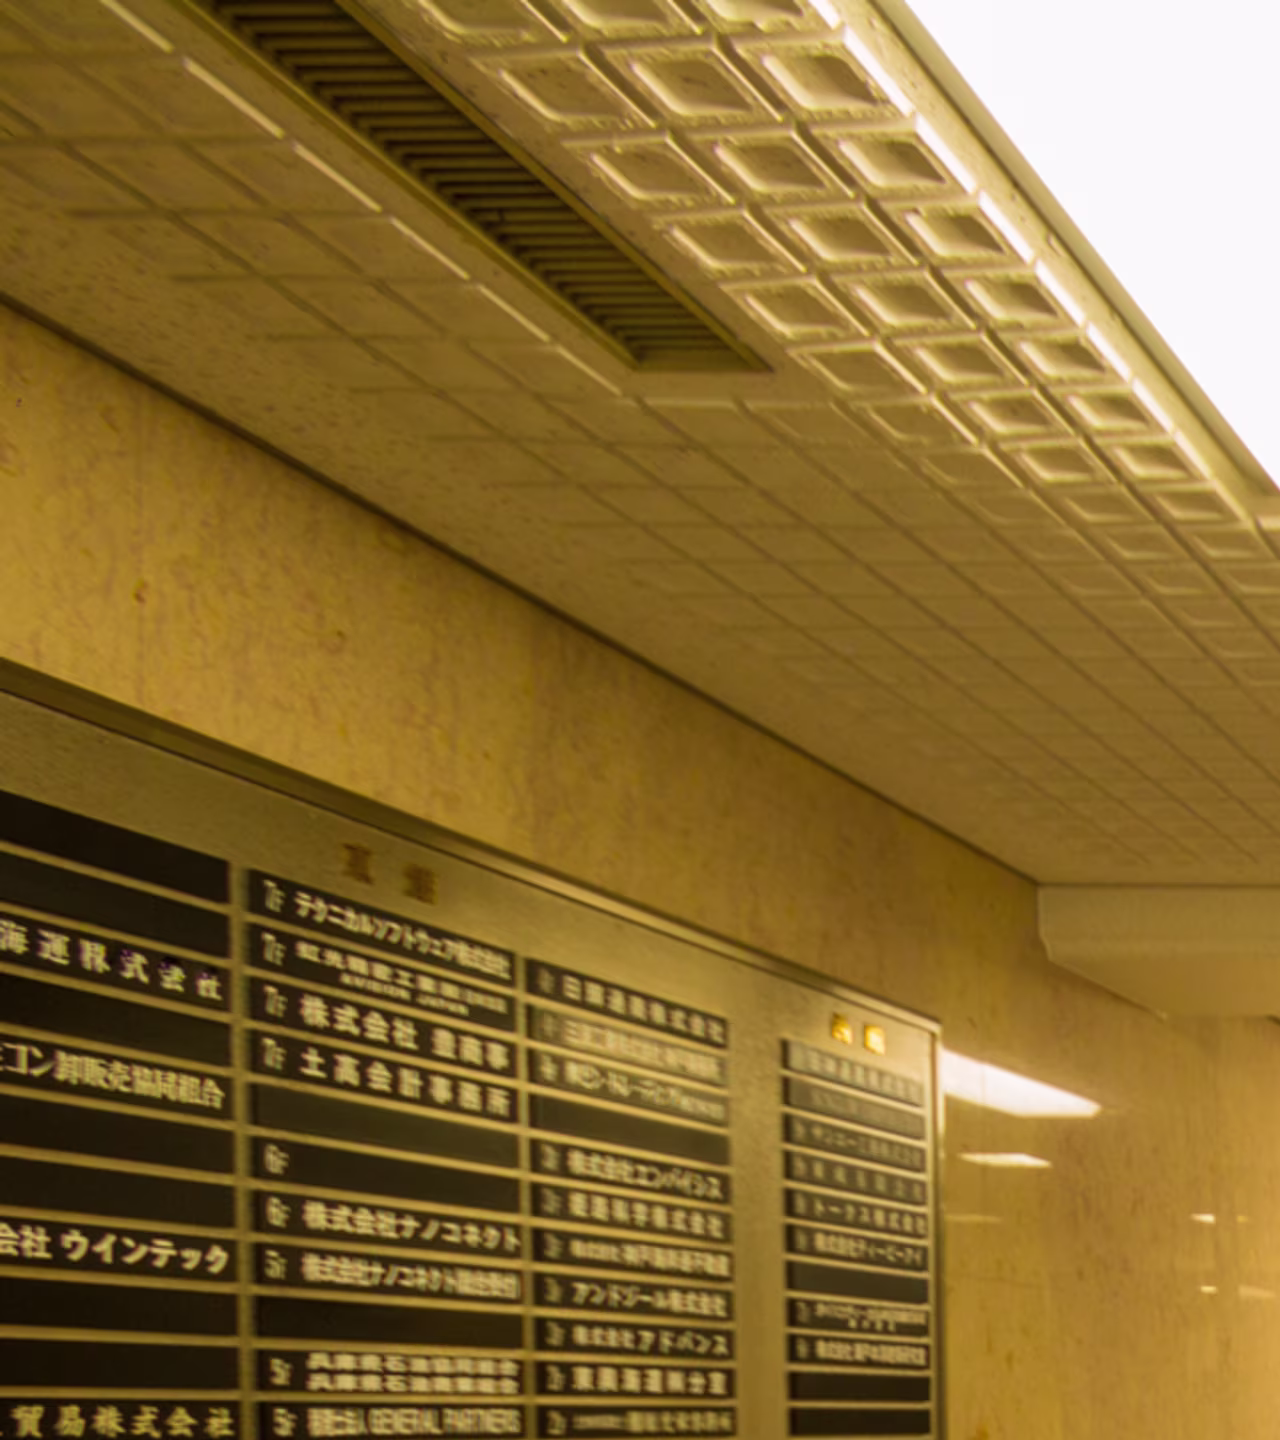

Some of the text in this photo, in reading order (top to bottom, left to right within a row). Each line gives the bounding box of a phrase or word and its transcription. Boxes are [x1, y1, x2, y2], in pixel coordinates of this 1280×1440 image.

[300, 993, 419, 1050] 株式会社
[0, 1041, 225, 1110] コン卸販売協同組合
[60, 1229, 229, 1274] ウインテック
[302, 1199, 521, 1253] 株式会社ナノコネクト
[0, 1405, 235, 1439] 貿易株式会社
